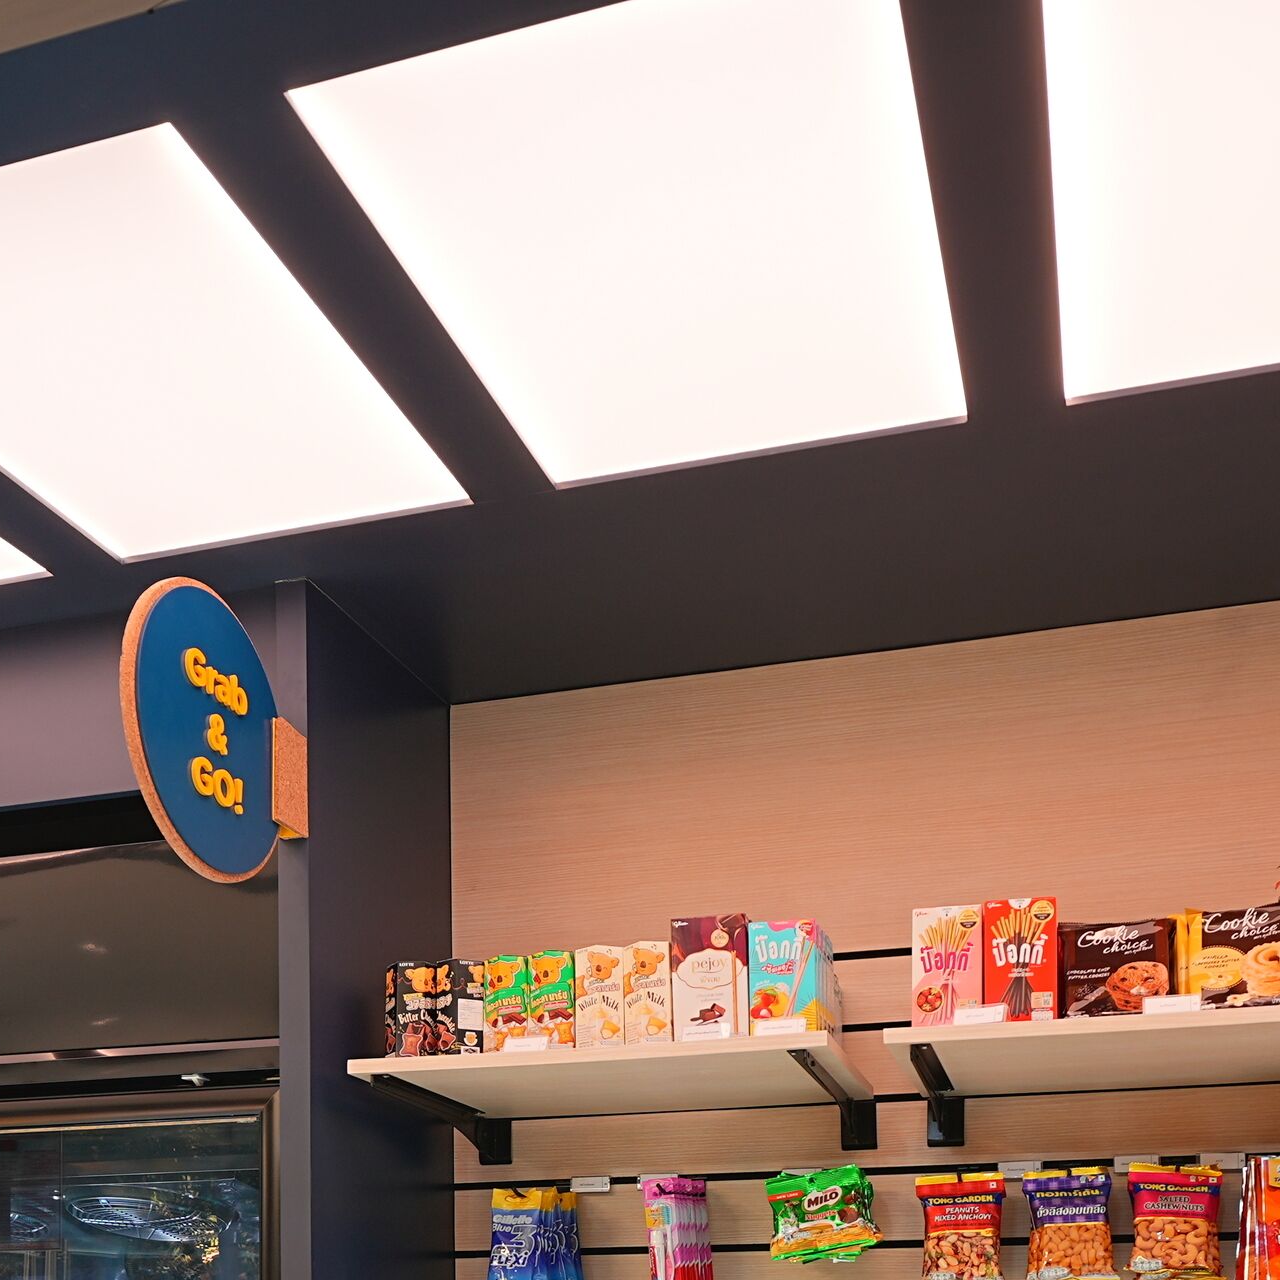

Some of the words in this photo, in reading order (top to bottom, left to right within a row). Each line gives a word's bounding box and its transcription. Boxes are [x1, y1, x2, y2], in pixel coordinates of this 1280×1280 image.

[184, 648, 248, 715] Grab
[207, 714, 228, 755] &
[191, 757, 243, 815] GO!
[1202, 907, 1270, 934] Cookie
[1077, 924, 1140, 949] Cookie
[1230, 923, 1278, 941] choice
[1103, 939, 1148, 955] choice
[691, 956, 728, 974] pejoy
[601, 994, 620, 1013] Milk
[646, 991, 666, 1008] Milk
[1139, 1183, 1166, 1191] TONG
[1167, 1185, 1209, 1193] GARDEN
[807, 1191, 839, 1208] MILO
[928, 1197, 953, 1205] TONG
[954, 1195, 993, 1203] GARDEN
[1144, 1201, 1181, 1210] CASHEW
[1181, 1203, 1205, 1212] NUTS
[1158, 1195, 1190, 1203] SALTED
[934, 1214, 957, 1222] MIXED
[957, 1212, 992, 1221] ANCHOVY
[945, 1206, 980, 1214] PEANUTS
[492, 1223, 511, 1233] Blue
[493, 1214, 533, 1225] Gillette
